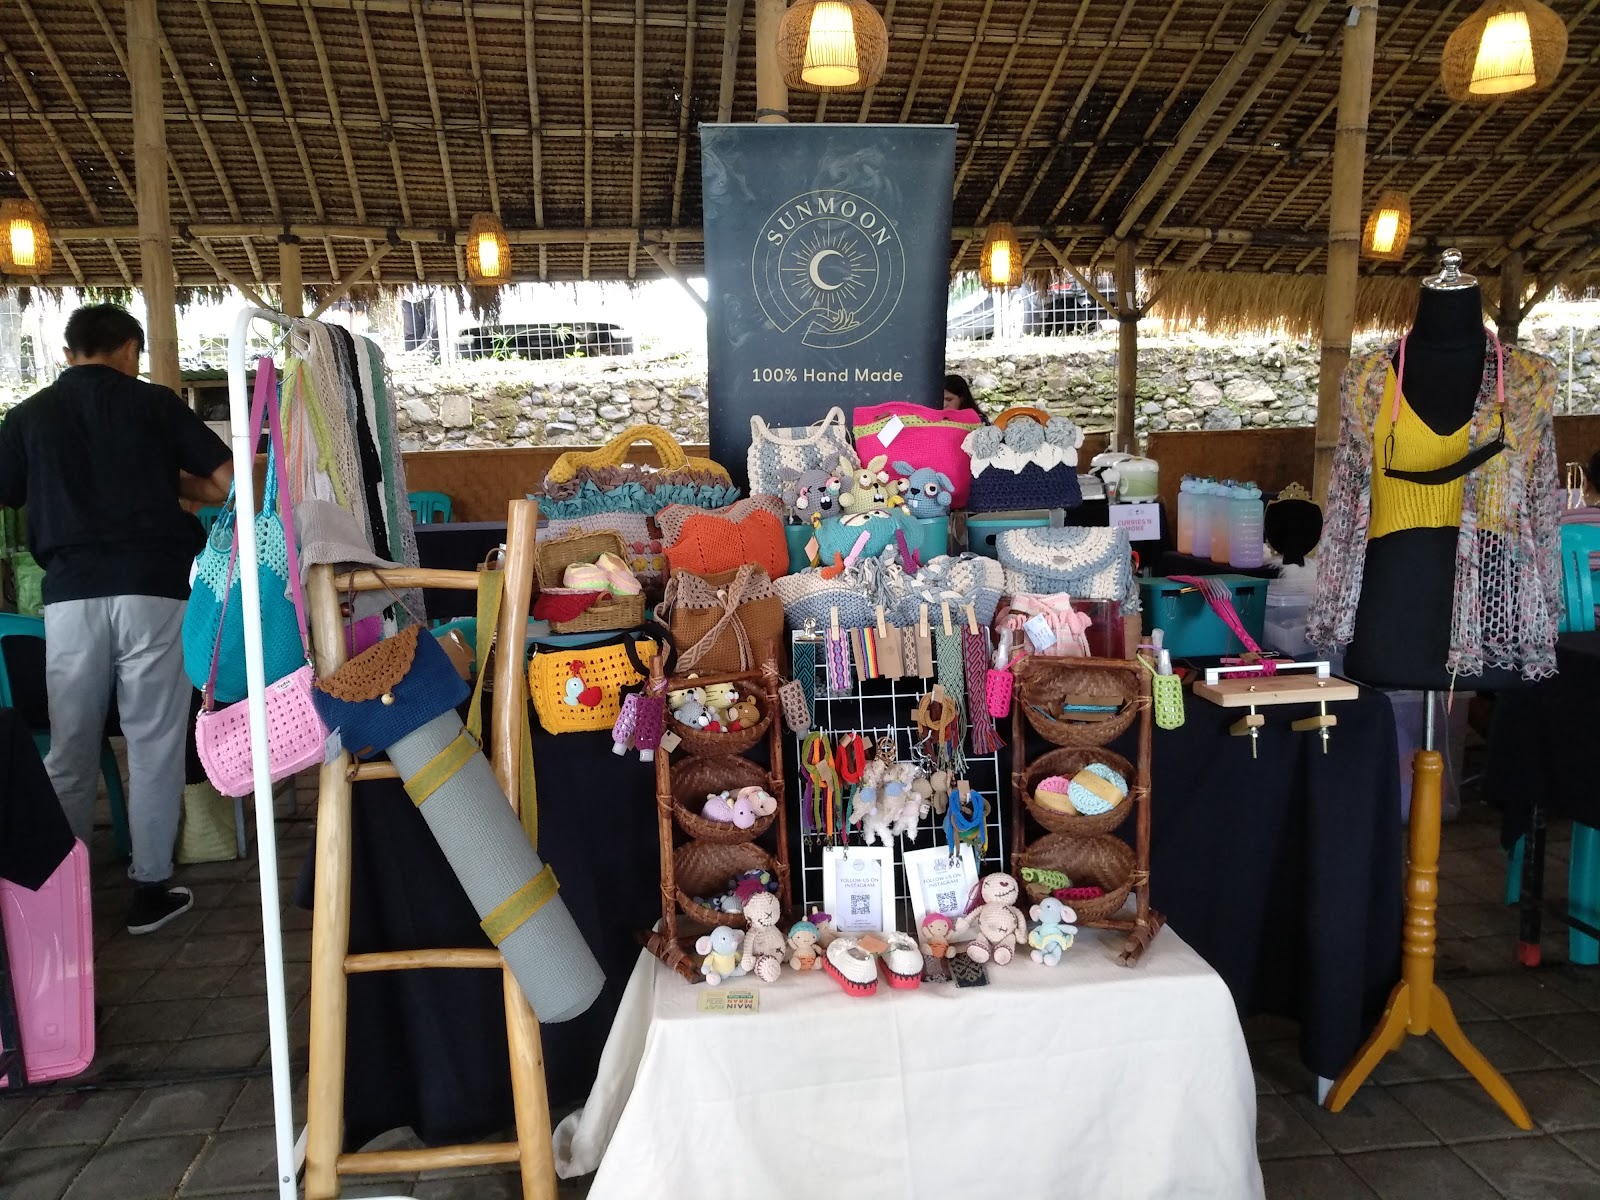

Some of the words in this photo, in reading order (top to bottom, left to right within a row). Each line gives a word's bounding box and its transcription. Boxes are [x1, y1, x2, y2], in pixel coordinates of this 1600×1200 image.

[767, 197, 892, 246] SUNMOON
[752, 368, 798, 383] 100%
[803, 367, 849, 383] Hand
[854, 367, 904, 383] Made
[923, 875, 945, 884] FOLLOW
[928, 879, 959, 888] INSTAGRAM
